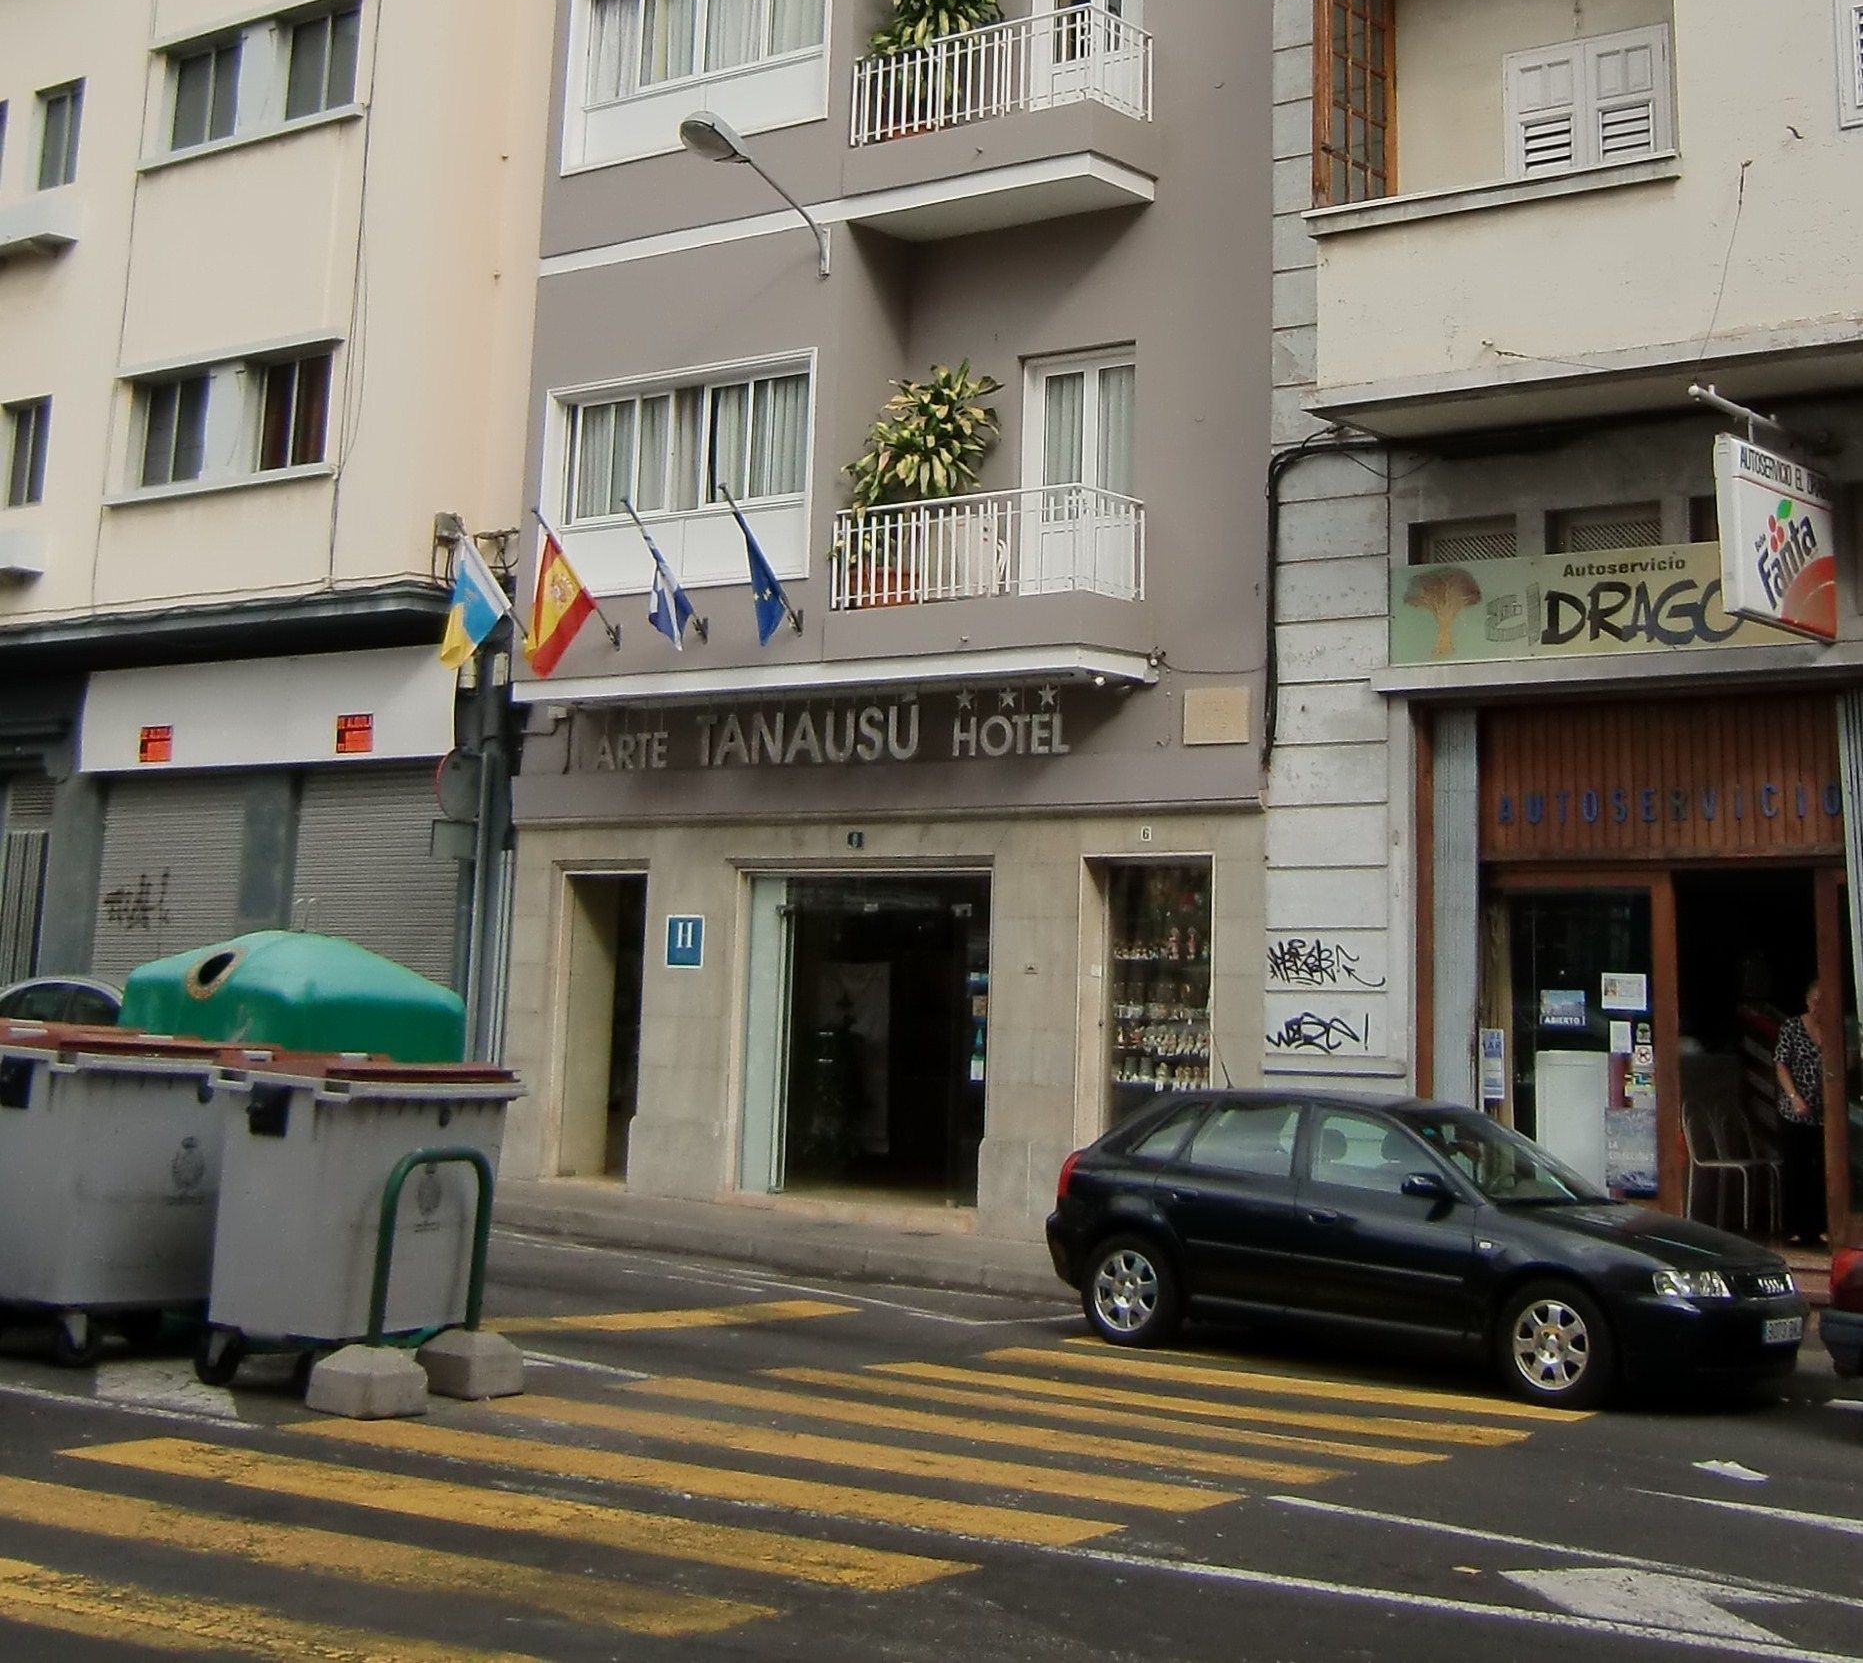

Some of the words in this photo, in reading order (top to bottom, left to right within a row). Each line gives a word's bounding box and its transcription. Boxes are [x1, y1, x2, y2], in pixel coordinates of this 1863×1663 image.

[1740, 445, 1791, 488] AUTOSERVICIO
[1795, 468, 1804, 491] EL
[1563, 556, 1686, 578] Autoservicio
[1757, 515, 1818, 611] Fanta
[1541, 579, 1743, 646] DRAGO
[597, 731, 669, 770] ARTE
[952, 713, 1071, 756] HOTEL
[1499, 782, 1842, 824] AUTOSERVICIO
[676, 921, 694, 948] H
